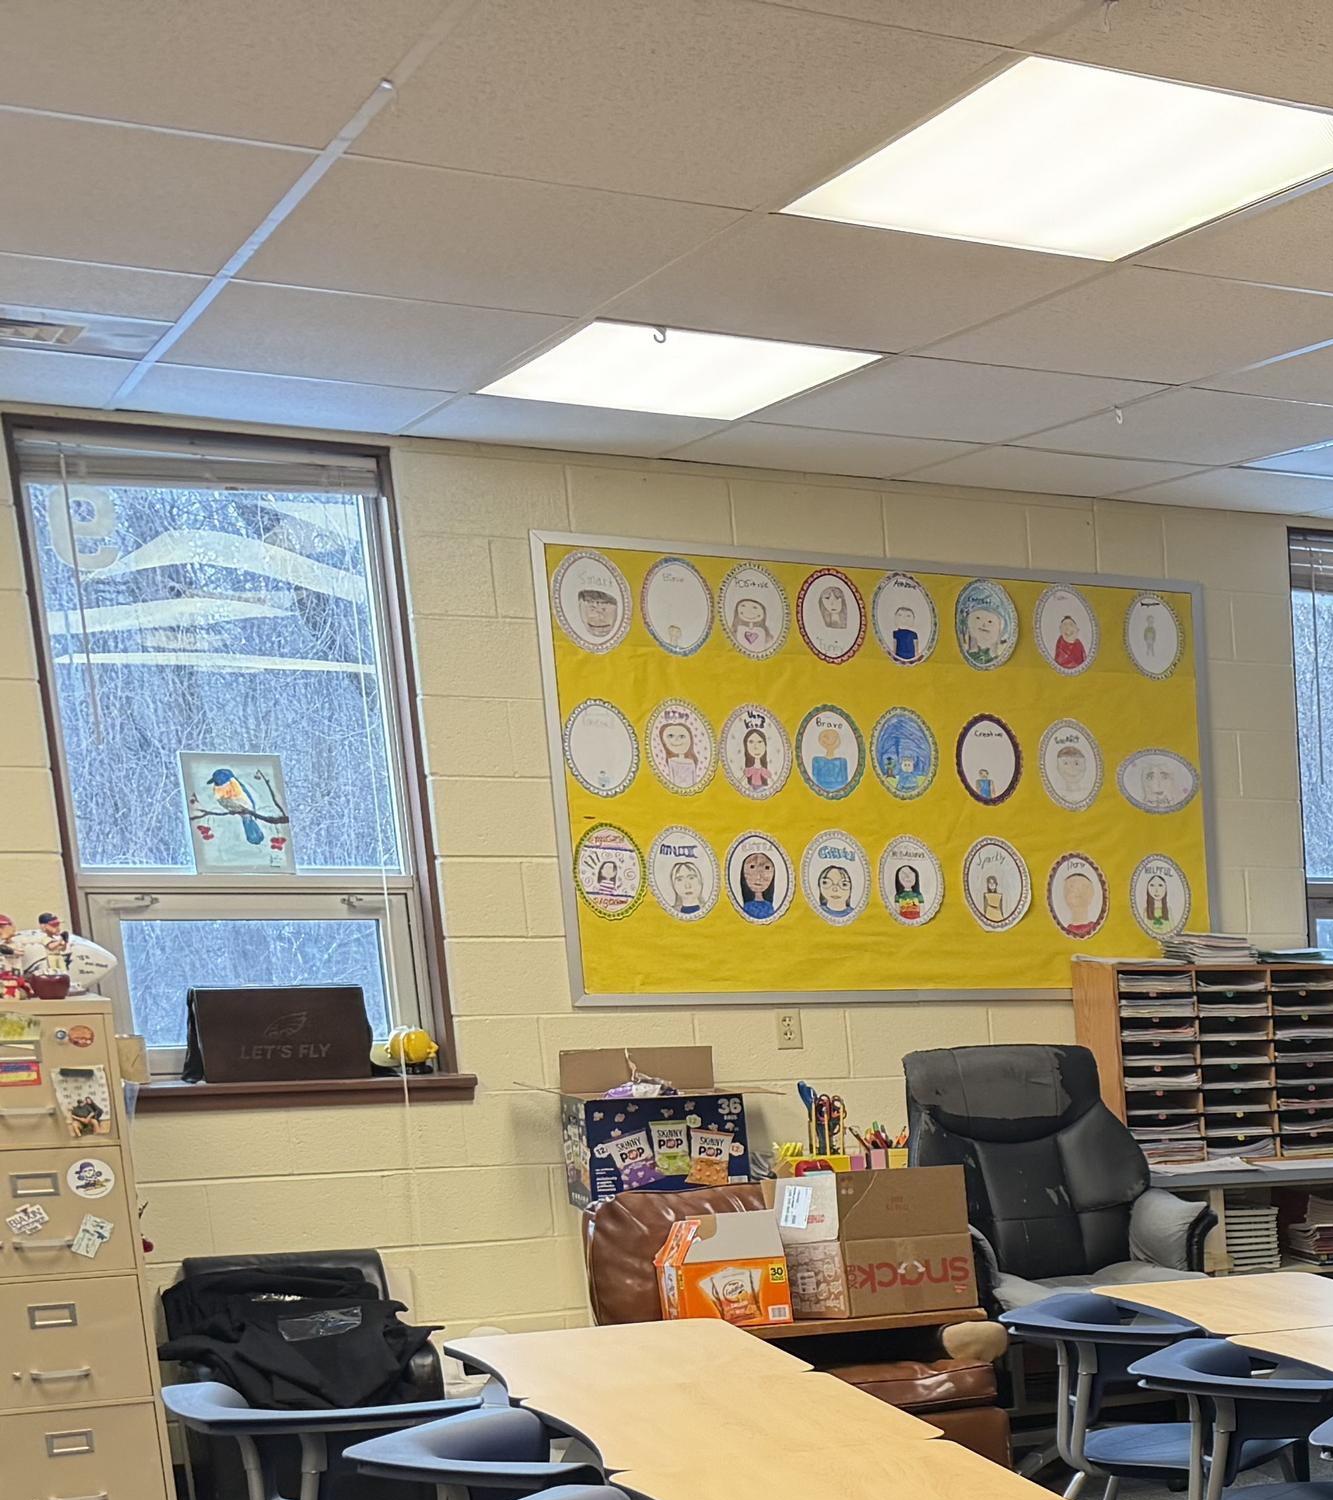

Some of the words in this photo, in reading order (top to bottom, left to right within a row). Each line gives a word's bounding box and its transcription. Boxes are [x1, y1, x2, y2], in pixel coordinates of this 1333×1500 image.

[815, 716, 843, 730] Brave
[240, 1043, 293, 1061] LET'S
[299, 1043, 331, 1059] FLY
[717, 1097, 743, 1115] 36
[657, 1128, 683, 1138] SKINNY
[615, 1136, 642, 1151] SKINNY
[658, 1138, 684, 1150] POP
[699, 1136, 725, 1147] SKINNY
[619, 1146, 645, 1164] POP
[698, 1145, 723, 1157] POP
[770, 1266, 784, 1277] 30
